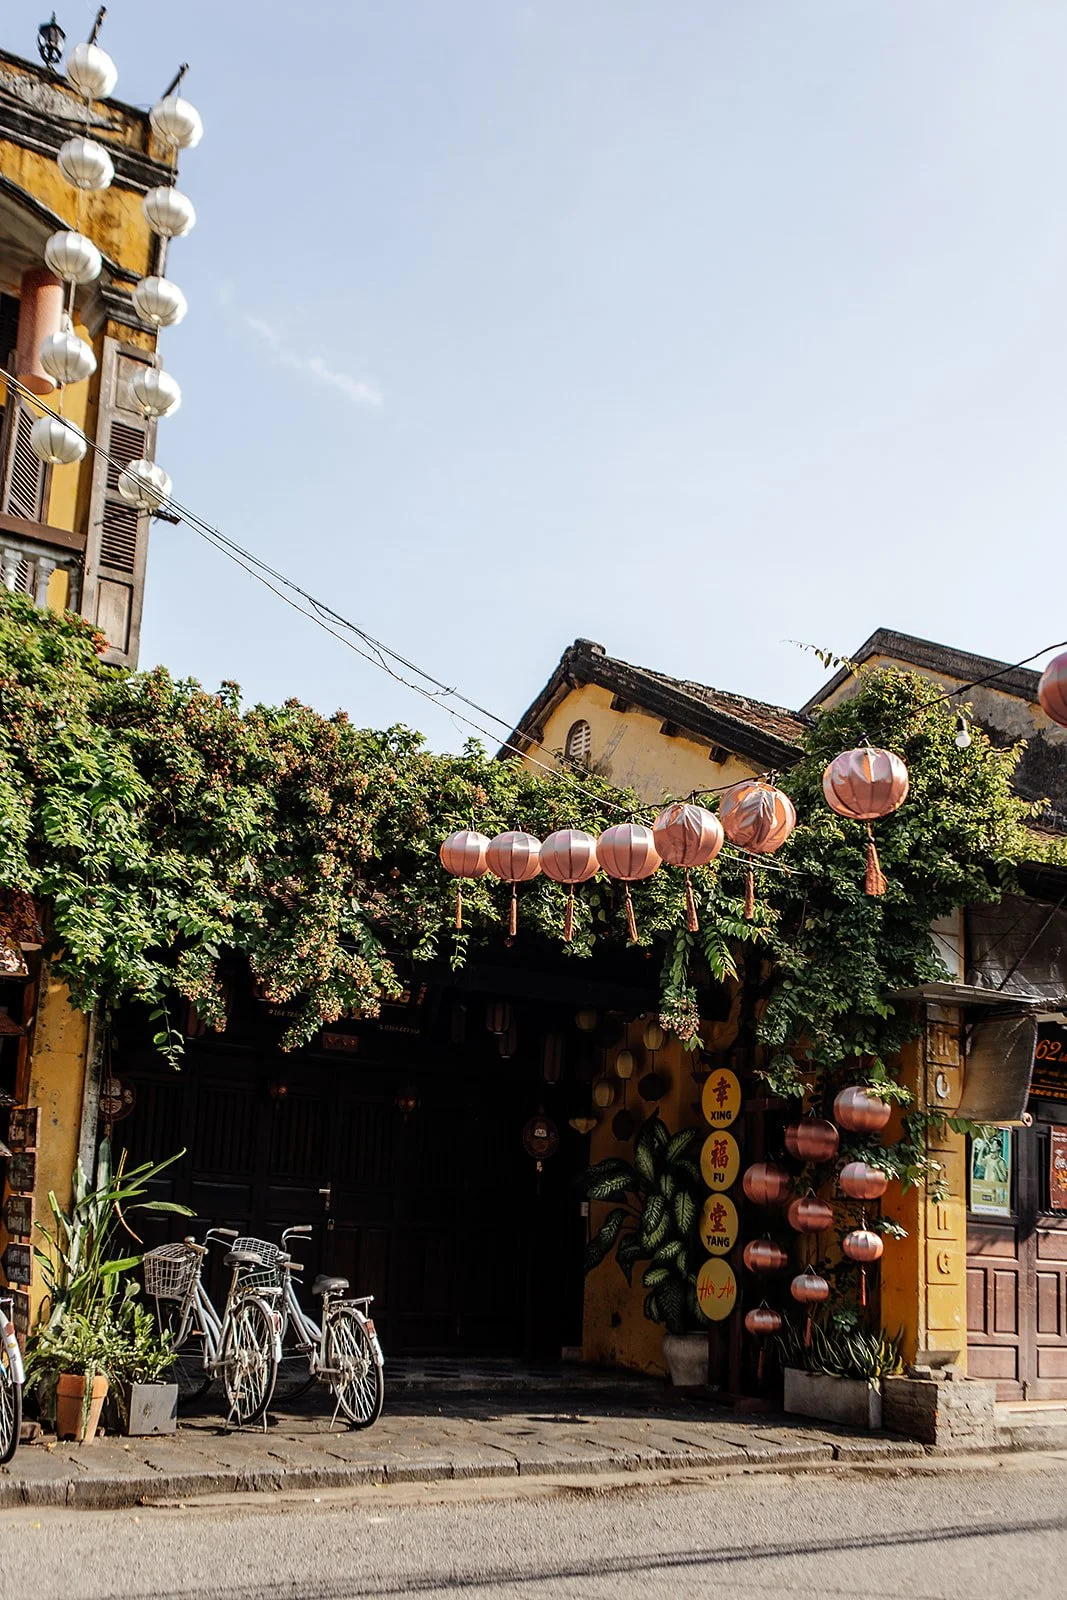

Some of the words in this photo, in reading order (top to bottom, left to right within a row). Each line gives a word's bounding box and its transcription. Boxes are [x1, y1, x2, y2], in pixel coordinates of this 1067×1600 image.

[1036, 1039, 1063, 1062] 62
[712, 1076, 731, 1109] 幸
[710, 1110, 732, 1121] XING
[711, 1139, 729, 1169] 福
[713, 1172, 725, 1183] FU
[710, 1201, 728, 1233] 堂
[706, 1235, 730, 1248] TANG
[717, 1276, 735, 1299] An
